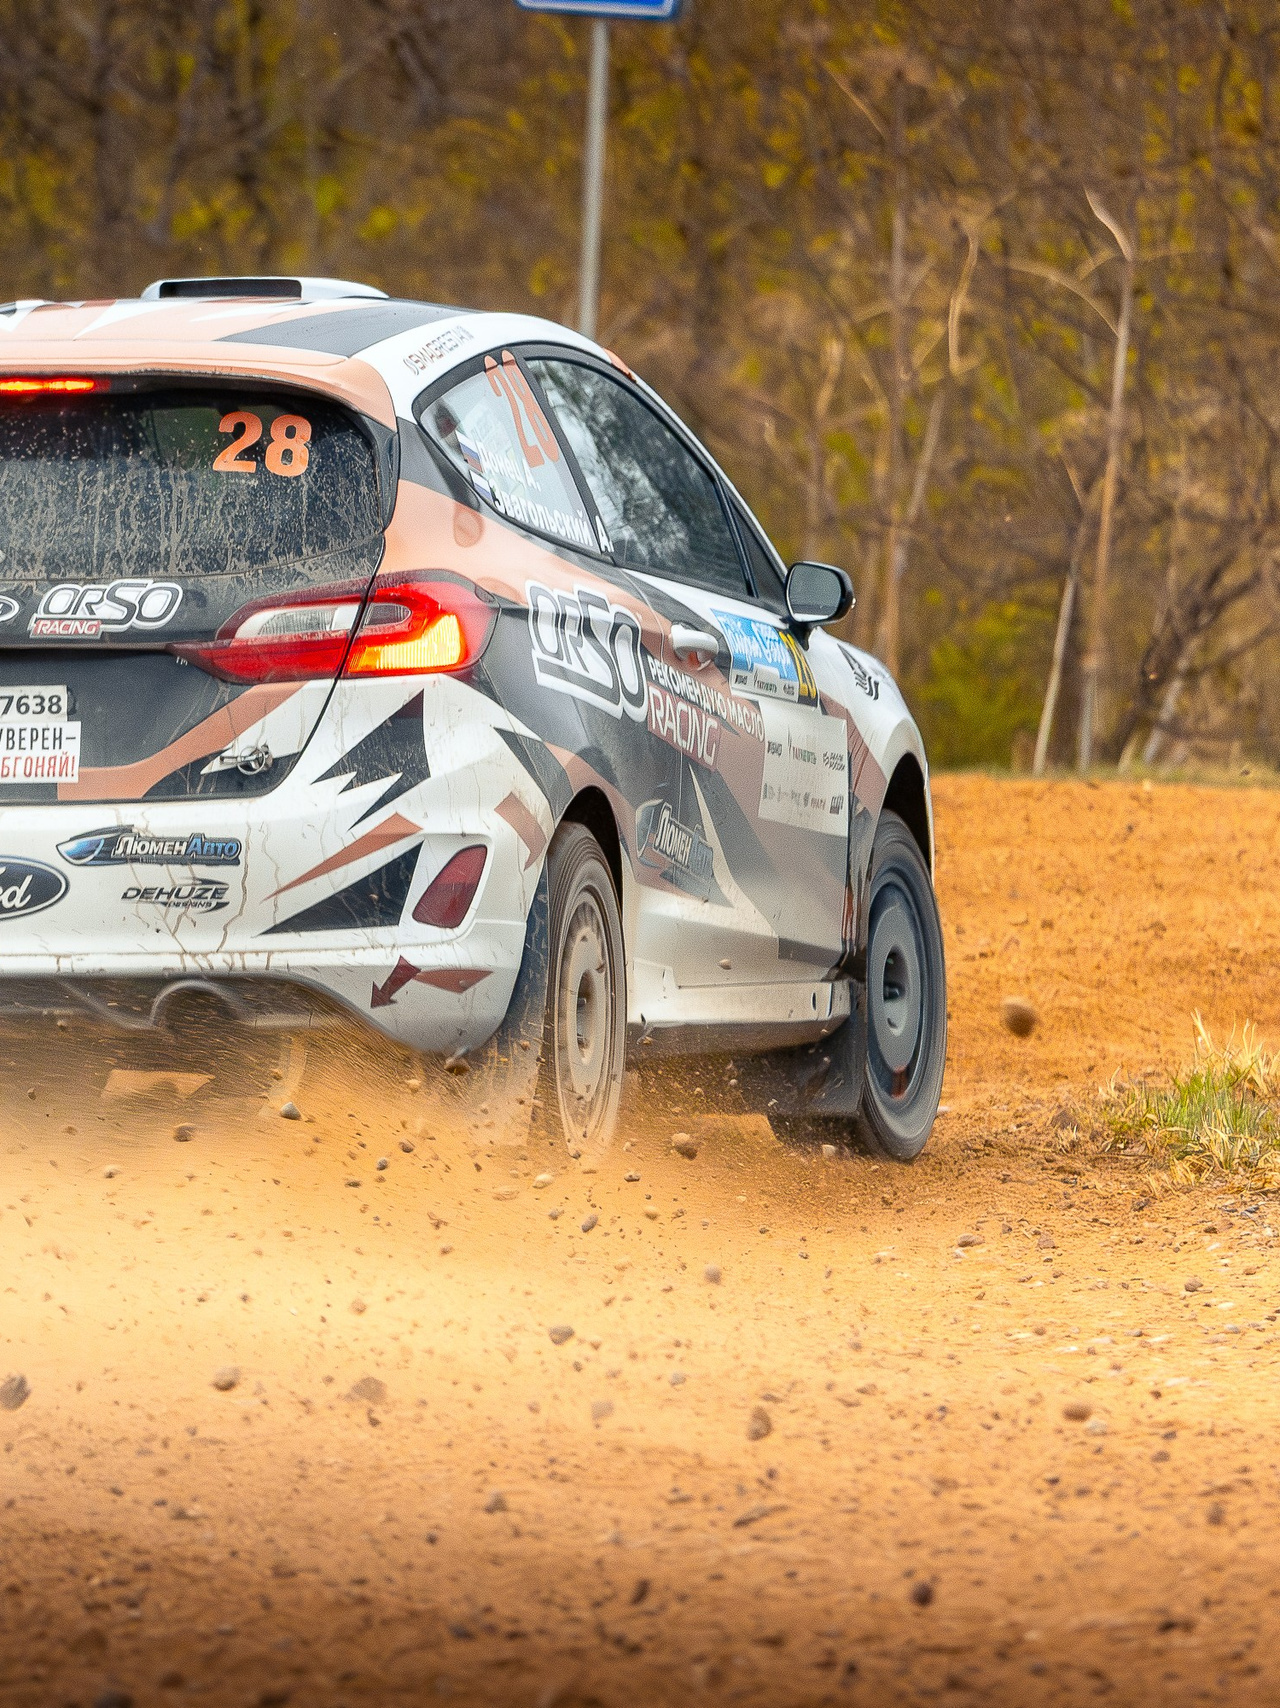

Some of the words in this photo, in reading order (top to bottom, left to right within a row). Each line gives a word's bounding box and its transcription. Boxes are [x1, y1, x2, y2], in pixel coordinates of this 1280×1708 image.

[484, 350, 559, 469] 28
[212, 411, 312, 478] 28
[37, 619, 99, 635] RACING
[0, 694, 62, 716] 7638
[649, 685, 718, 766] RACING
[727, 697, 764, 742] МАСЛО
[121, 886, 229, 900] DEHUZE
